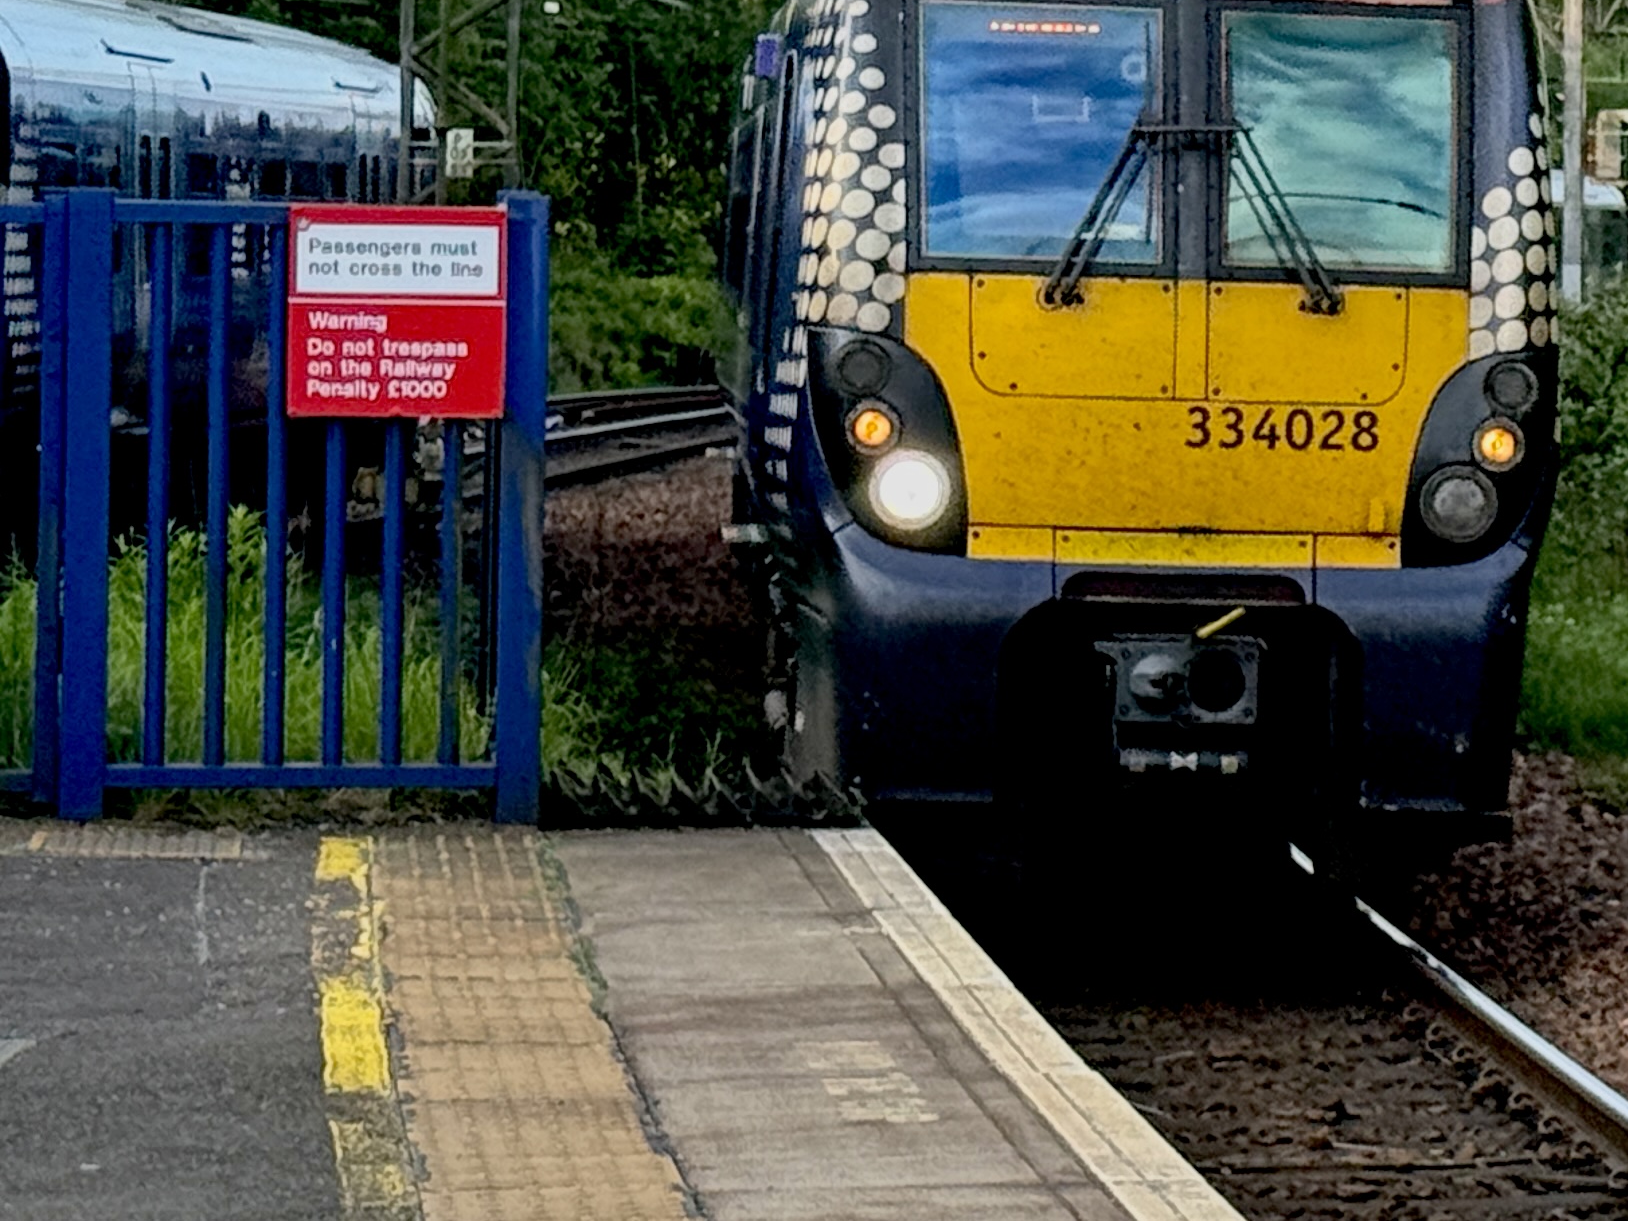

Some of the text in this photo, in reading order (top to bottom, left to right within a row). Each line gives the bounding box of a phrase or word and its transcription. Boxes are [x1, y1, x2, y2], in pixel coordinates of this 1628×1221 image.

[309, 237, 478, 257] Passengers must
[309, 259, 483, 277] not cross the line
[308, 311, 388, 334] Warning
[306, 338, 469, 359] Do not trespass
[307, 359, 456, 381] on the Railway
[306, 379, 448, 401] Penalty £1000
[1184, 406, 1379, 453] 334028
